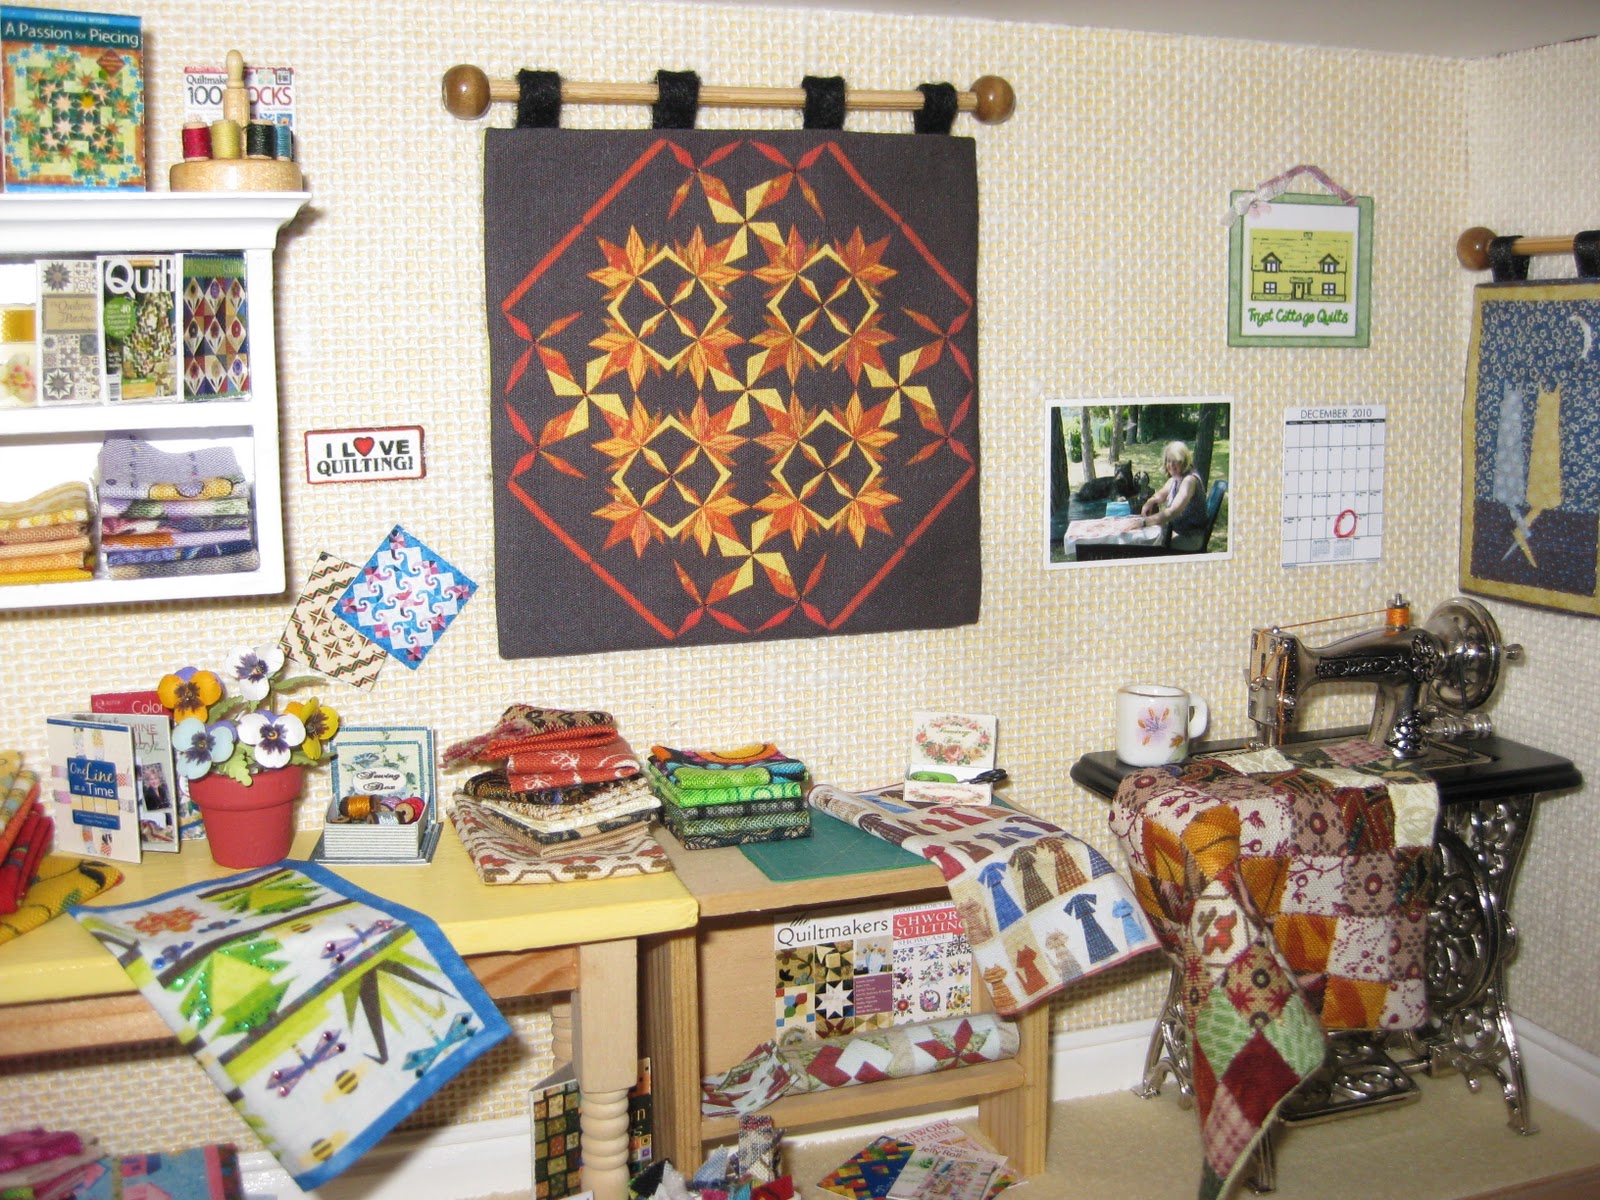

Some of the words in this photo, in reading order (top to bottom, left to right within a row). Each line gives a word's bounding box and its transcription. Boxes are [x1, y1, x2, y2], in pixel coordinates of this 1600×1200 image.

[5, 21, 16, 36] A
[19, 22, 73, 40] Passion
[89, 28, 139, 48] Piecing
[188, 86, 223, 105] 100
[105, 258, 175, 299] Quilt
[1248, 307, 1274, 327] Tryst
[1276, 308, 1315, 328] Cottage
[1317, 308, 1348, 326] Quilts
[1300, 408, 1348, 419] DECEMBER
[1352, 408, 1372, 417] 2010
[326, 443, 332, 458] I
[317, 456, 413, 477] QUILTING!
[69, 762, 86, 774] One
[85, 762, 115, 783] Line
[356, 771, 400, 781] Sewing
[85, 782, 114, 797] Time
[362, 782, 396, 792] Box
[894, 911, 958, 927] CHWOR
[777, 919, 888, 946] Quiltmakers
[898, 934, 947, 946] SHOWCASE
[918, 1146, 941, 1155] Jelly
[942, 1150, 962, 1158] Roll
